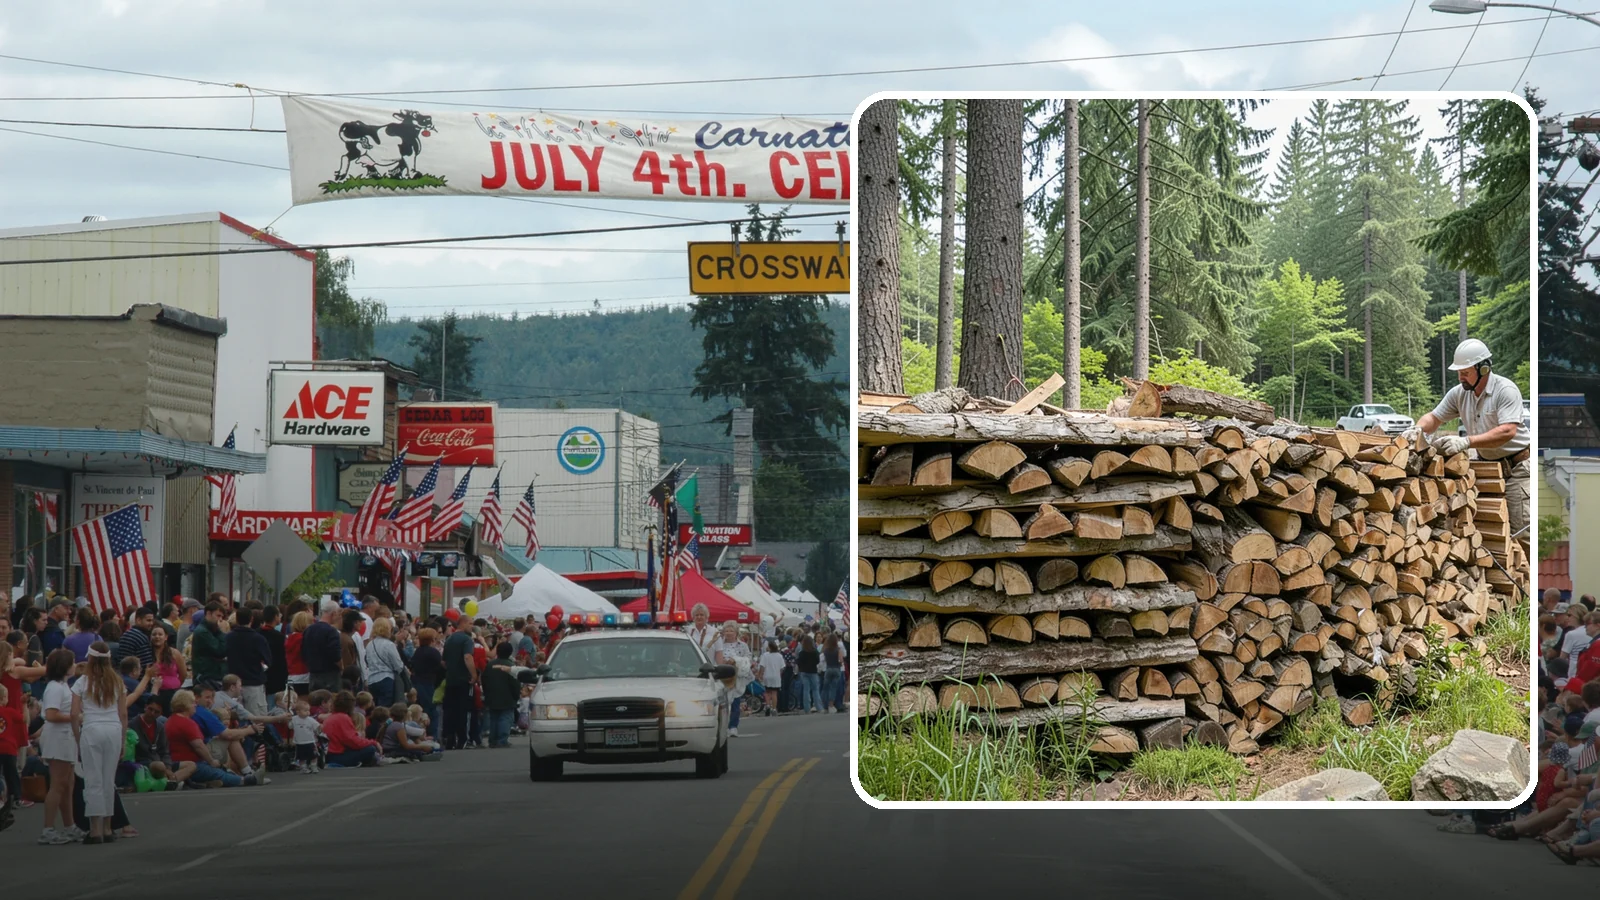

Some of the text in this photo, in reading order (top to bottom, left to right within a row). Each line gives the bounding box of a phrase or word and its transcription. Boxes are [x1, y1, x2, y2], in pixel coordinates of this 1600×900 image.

[694, 121, 849, 149] Carnat
[481, 141, 605, 192] JULY
[632, 150, 745, 197] 4th.
[696, 253, 849, 280] CROSSWA
[282, 380, 373, 420] ACE
[405, 409, 453, 421] CEDAR
[283, 421, 371, 436] Hardware
[416, 428, 477, 447] Coca-Cola
[353, 467, 385, 480] Simpl
[83, 485, 155, 495] St. Vincent de Paul
[688, 526, 741, 535] CRNATION
[699, 535, 730, 543] GLASS
